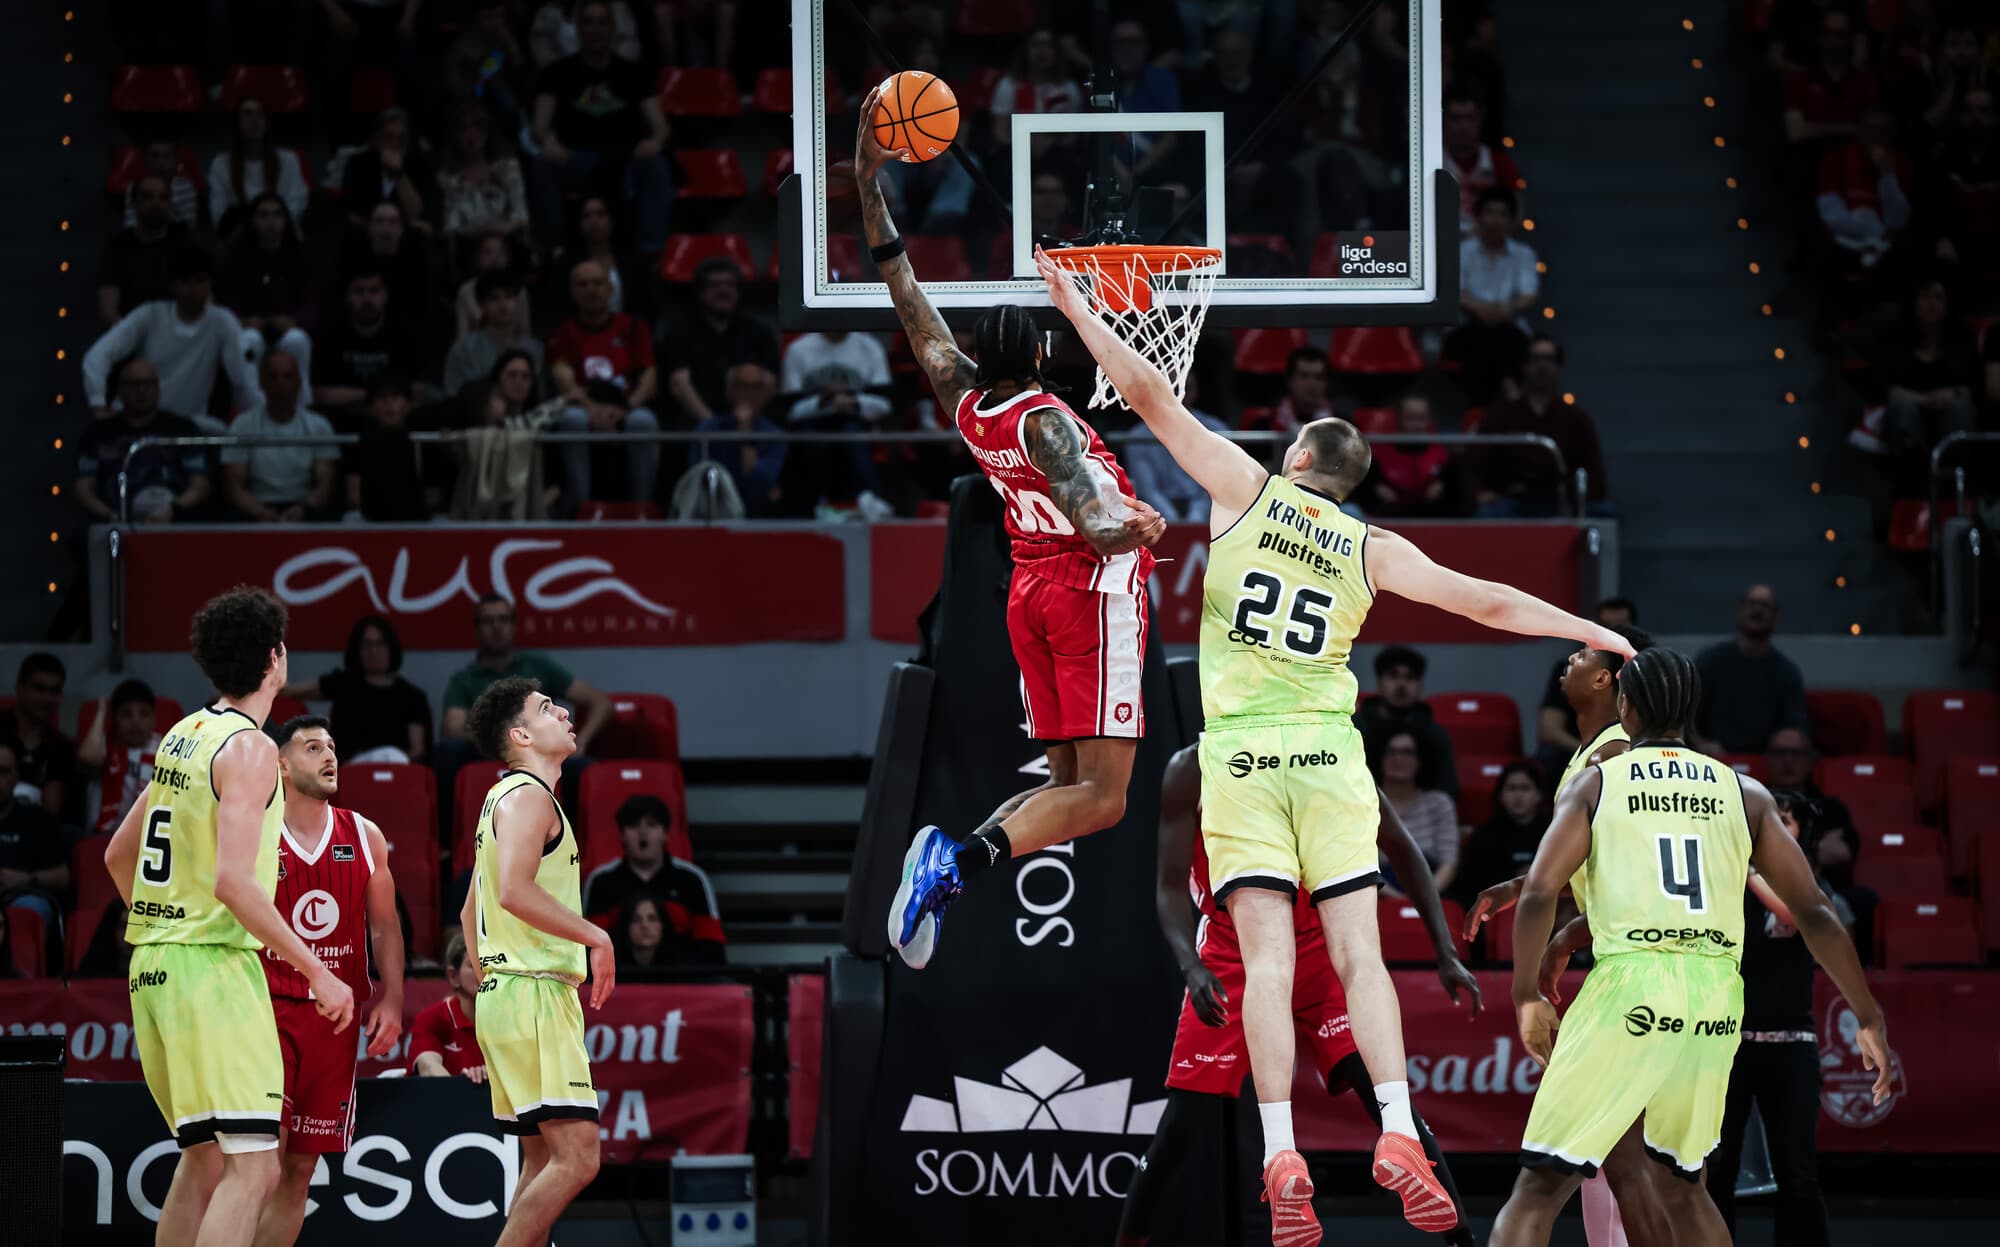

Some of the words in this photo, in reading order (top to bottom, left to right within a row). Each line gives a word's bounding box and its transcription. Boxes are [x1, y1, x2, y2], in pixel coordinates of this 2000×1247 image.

[1341, 244, 1371, 261] liga
[1341, 259, 1407, 274] endesa
[1266, 498, 1353, 557] KRUTWIG
[273, 538, 677, 615] aura
[1232, 567, 1337, 658] 25
[1629, 760, 1718, 783] AGADA
[139, 804, 174, 889] 5
[1655, 832, 1708, 915] 4
[914, 1149, 1140, 1199] SOMMO
